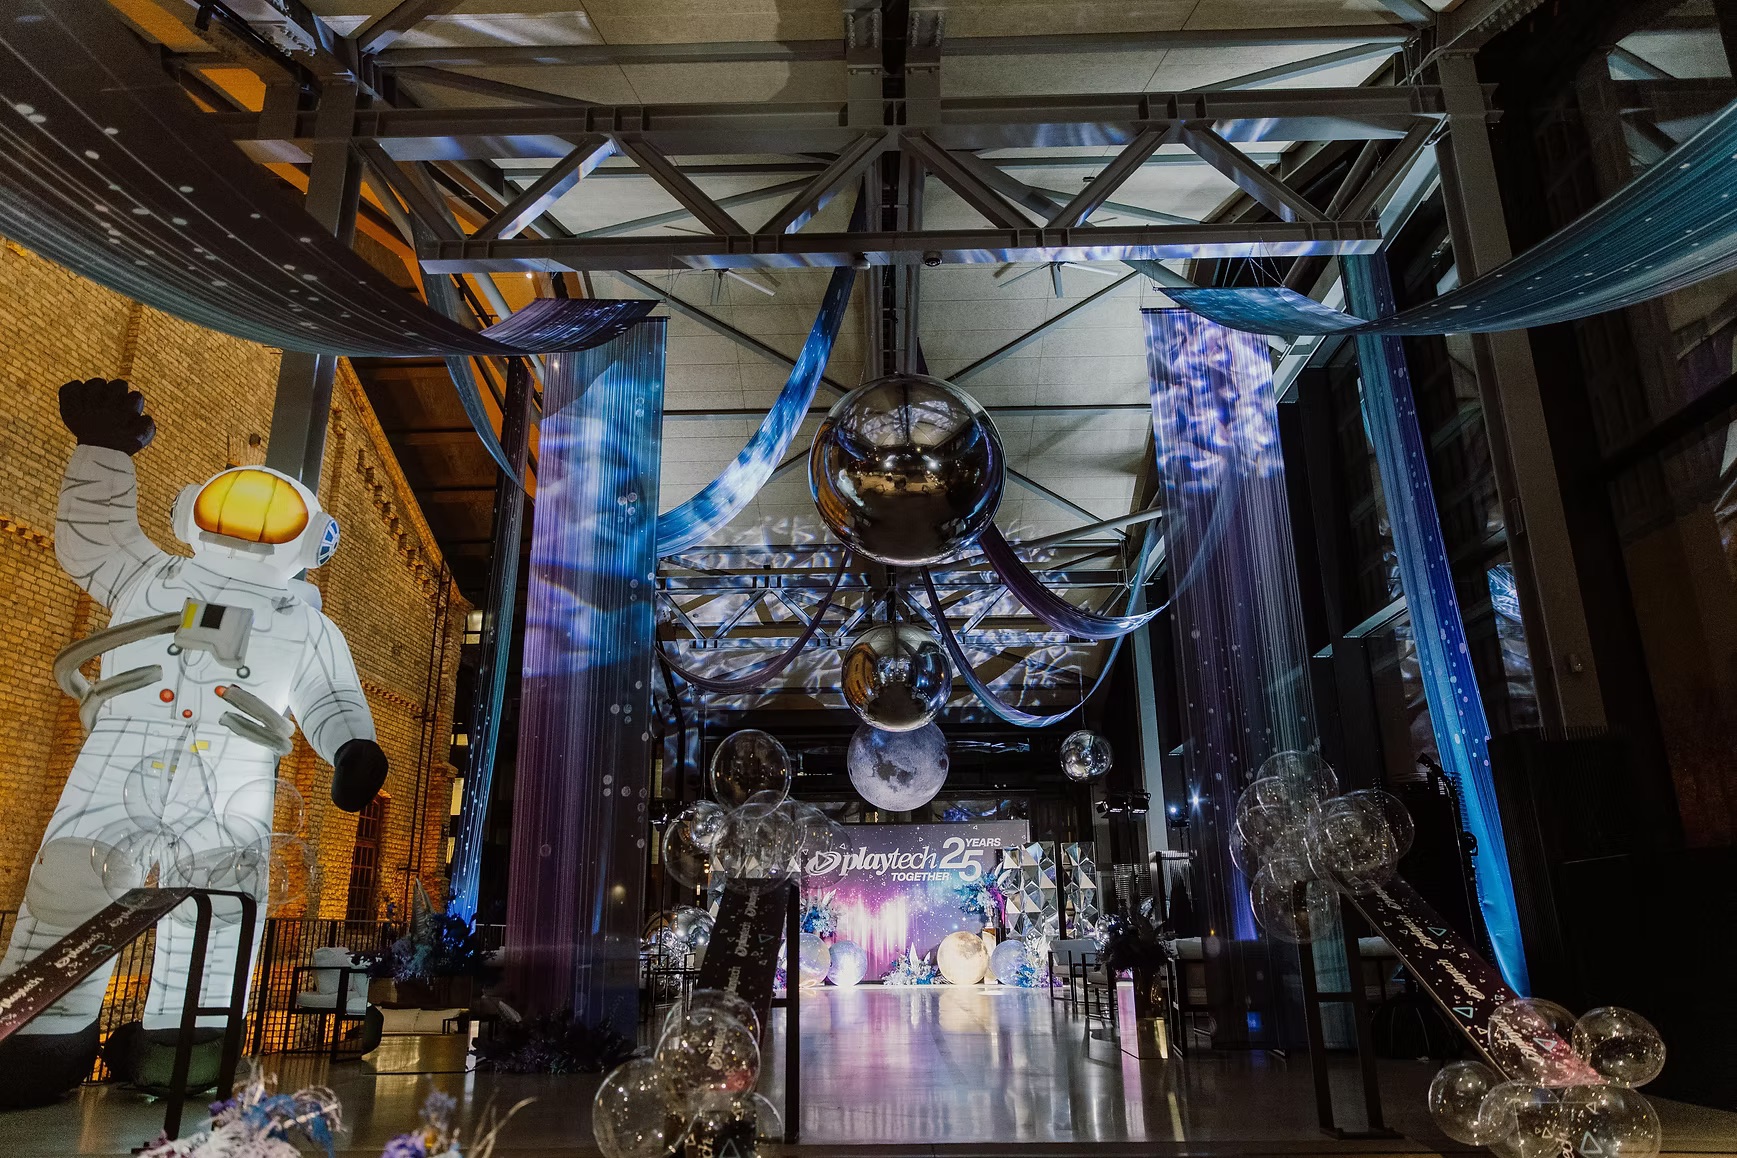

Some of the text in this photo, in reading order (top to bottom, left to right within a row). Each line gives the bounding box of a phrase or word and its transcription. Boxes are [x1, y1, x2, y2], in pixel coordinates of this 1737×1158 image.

[964, 837, 1001, 847] YEARS
[838, 836, 984, 882] playtech 25
[891, 872, 950, 882] TOGETHER
